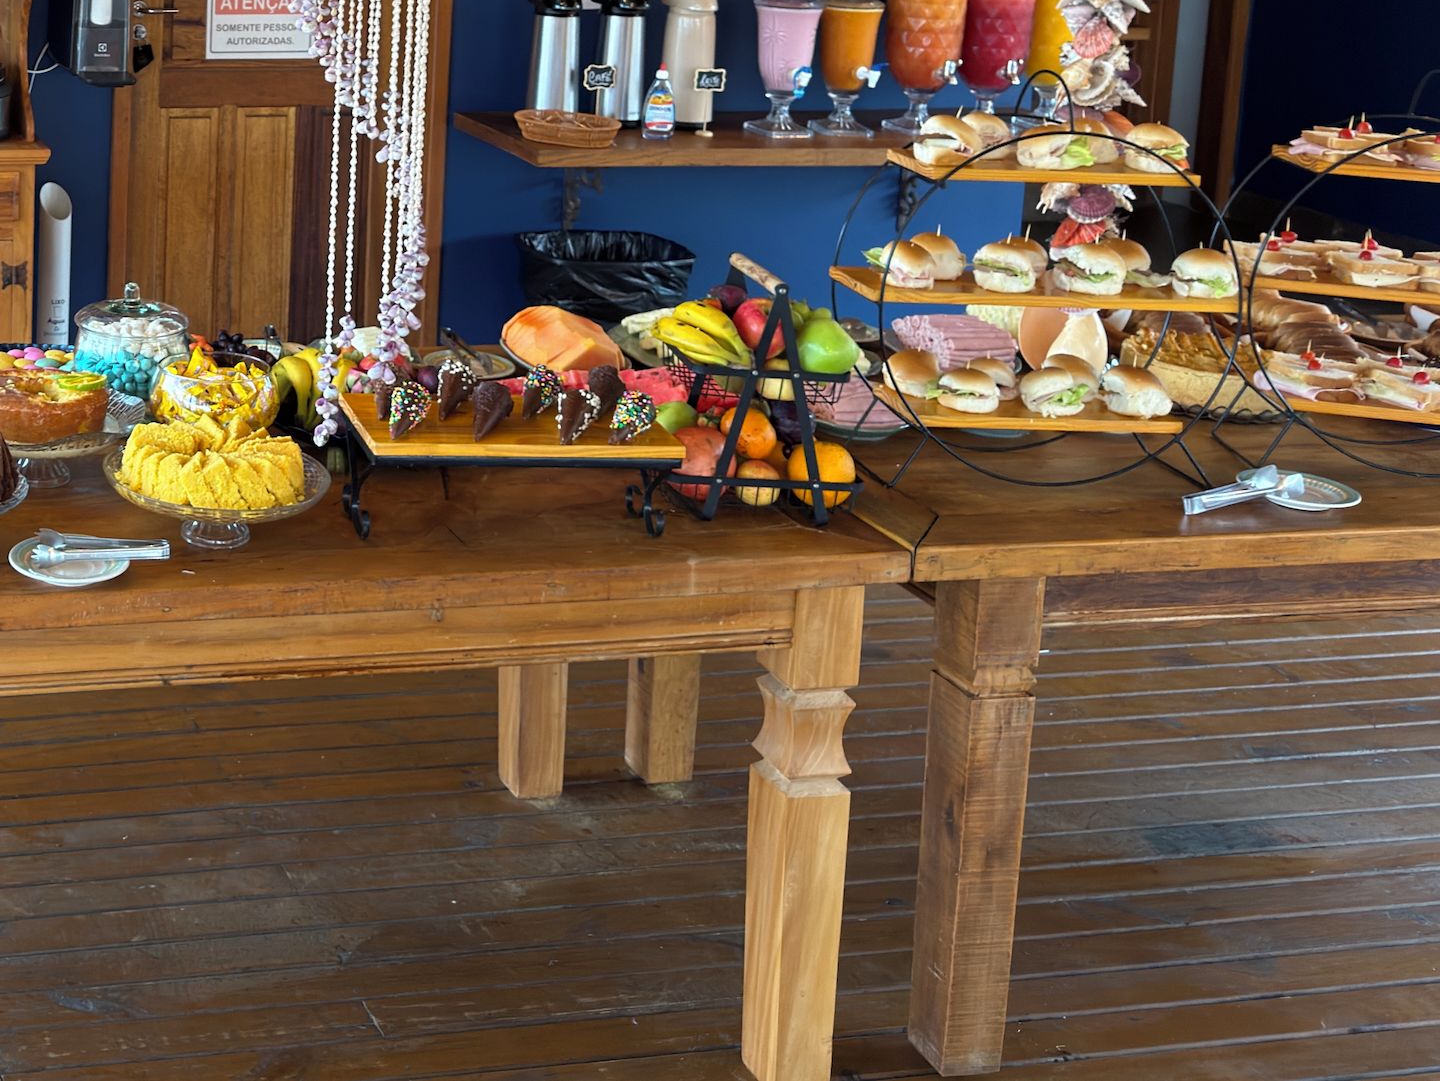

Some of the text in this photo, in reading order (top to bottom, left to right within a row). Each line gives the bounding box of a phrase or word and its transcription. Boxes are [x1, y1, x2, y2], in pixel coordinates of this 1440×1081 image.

[215, 23, 297, 32] SOMENTE PESSO
[226, 36, 295, 46] AUTORIZADAS.
